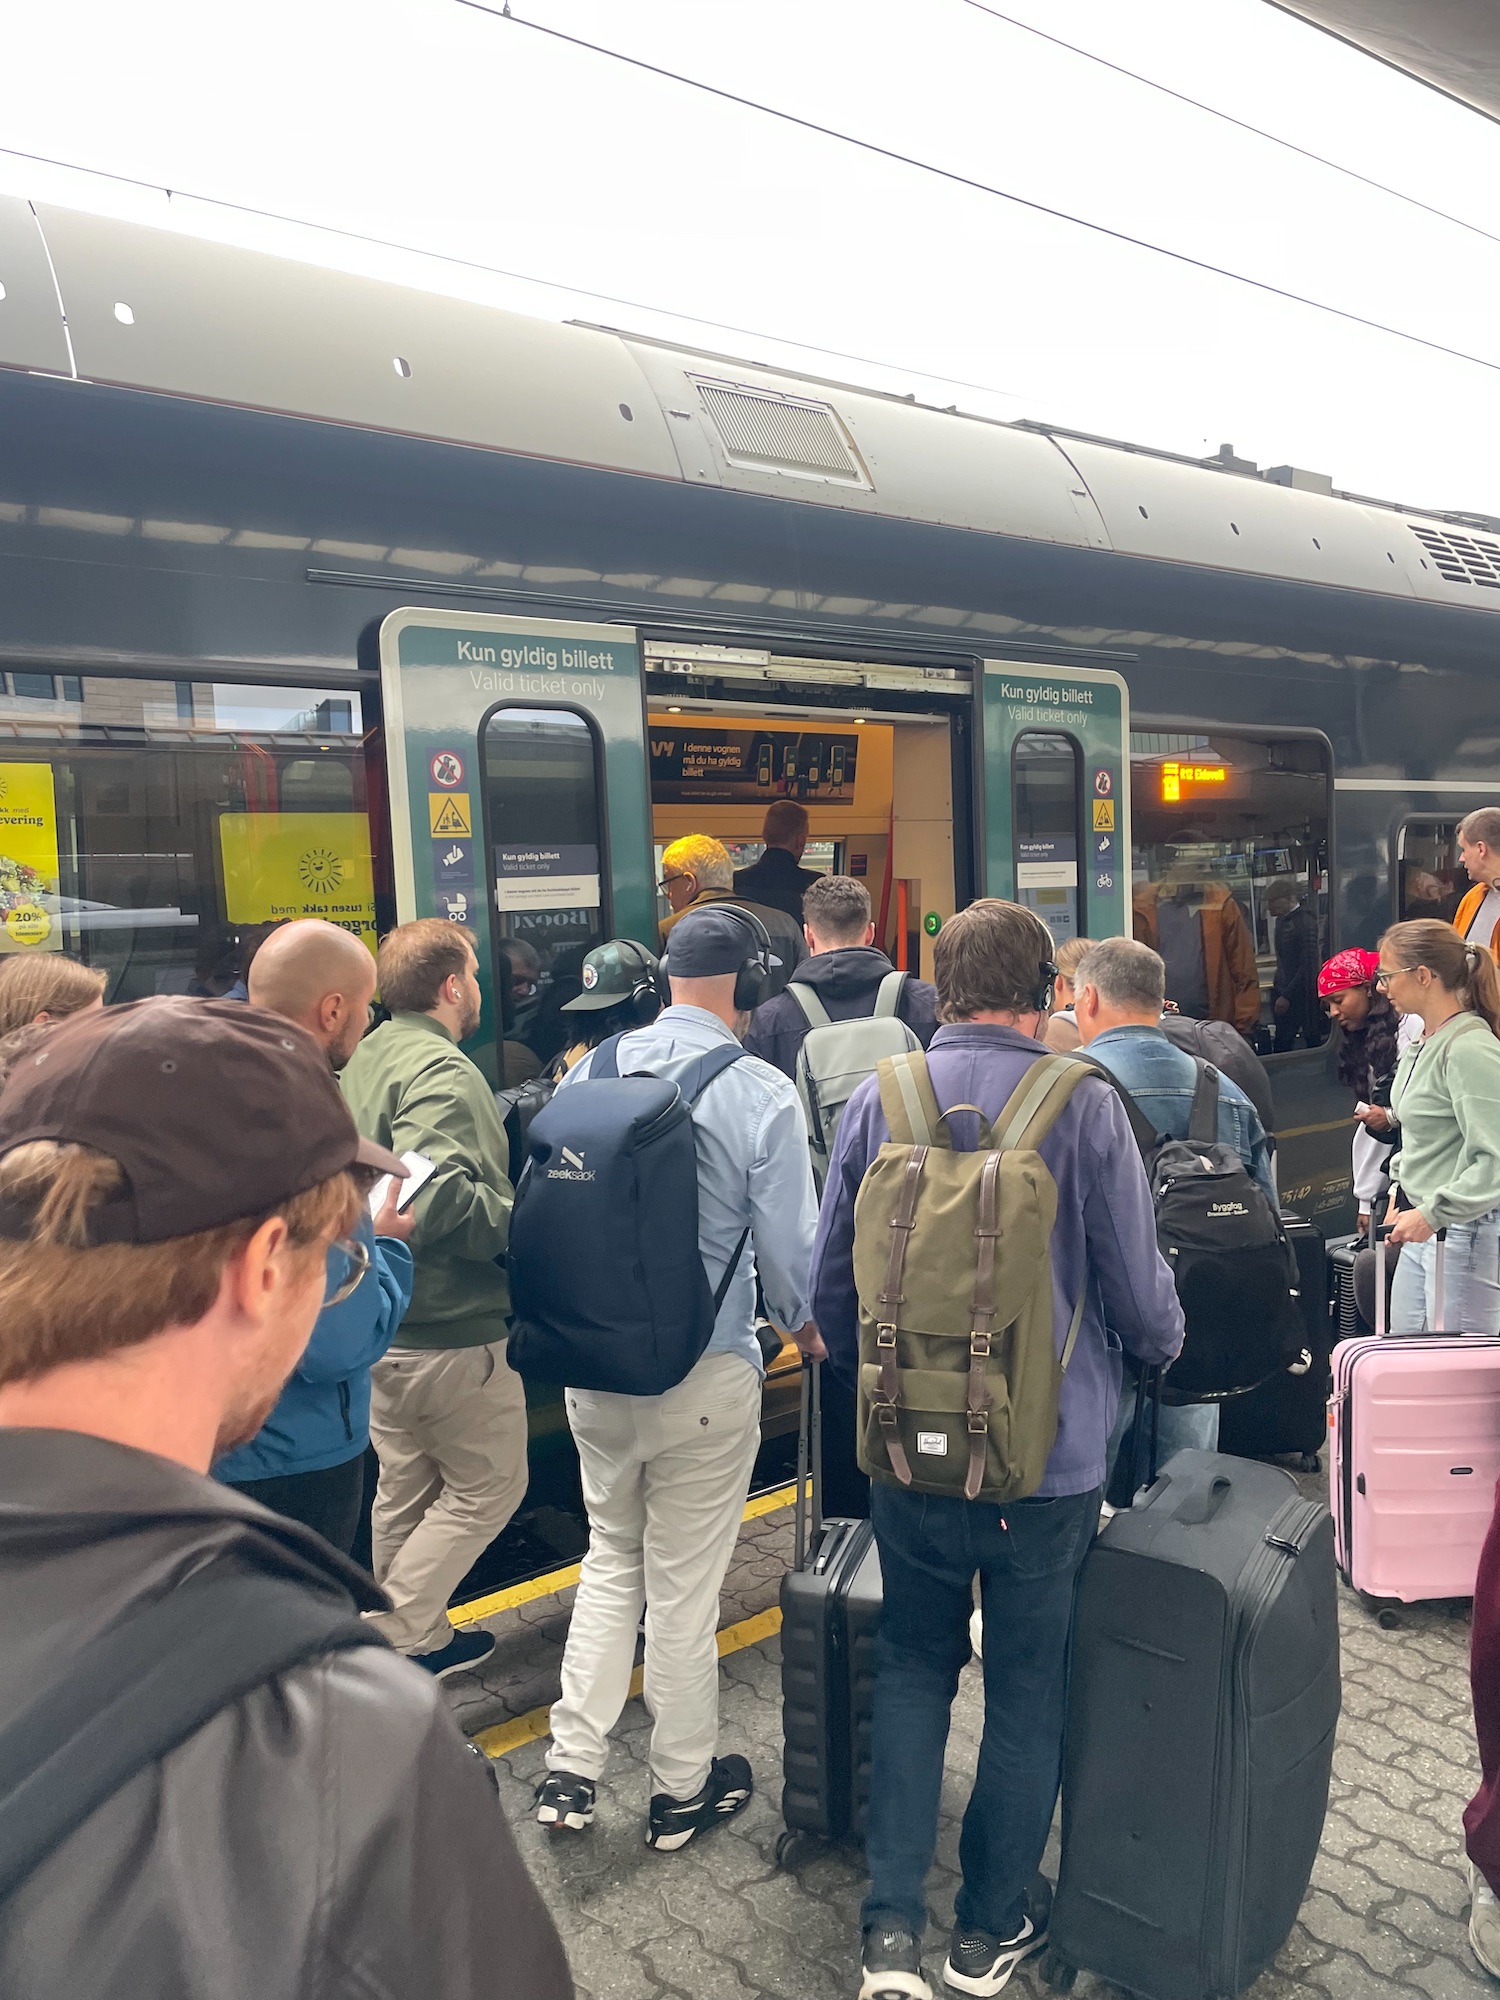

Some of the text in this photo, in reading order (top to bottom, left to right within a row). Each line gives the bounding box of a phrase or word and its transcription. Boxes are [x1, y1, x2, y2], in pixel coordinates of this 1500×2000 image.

[456, 640, 615, 671] Kun gyldig billett
[469, 670, 606, 701] Valid ticket only
[1001, 683, 1094, 705] Kun gyldig billett
[1007, 705, 1088, 728] Valid ticket only
[687, 743, 713, 753] denne
[713, 745, 741, 755] vognen
[682, 755, 742, 768] må du ha gyldig
[681, 767, 705, 777] billett
[502, 852, 561, 862] Kun gyldig billett
[502, 862, 551, 871] Valid ticket only
[15, 912, 42, 923] 20%
